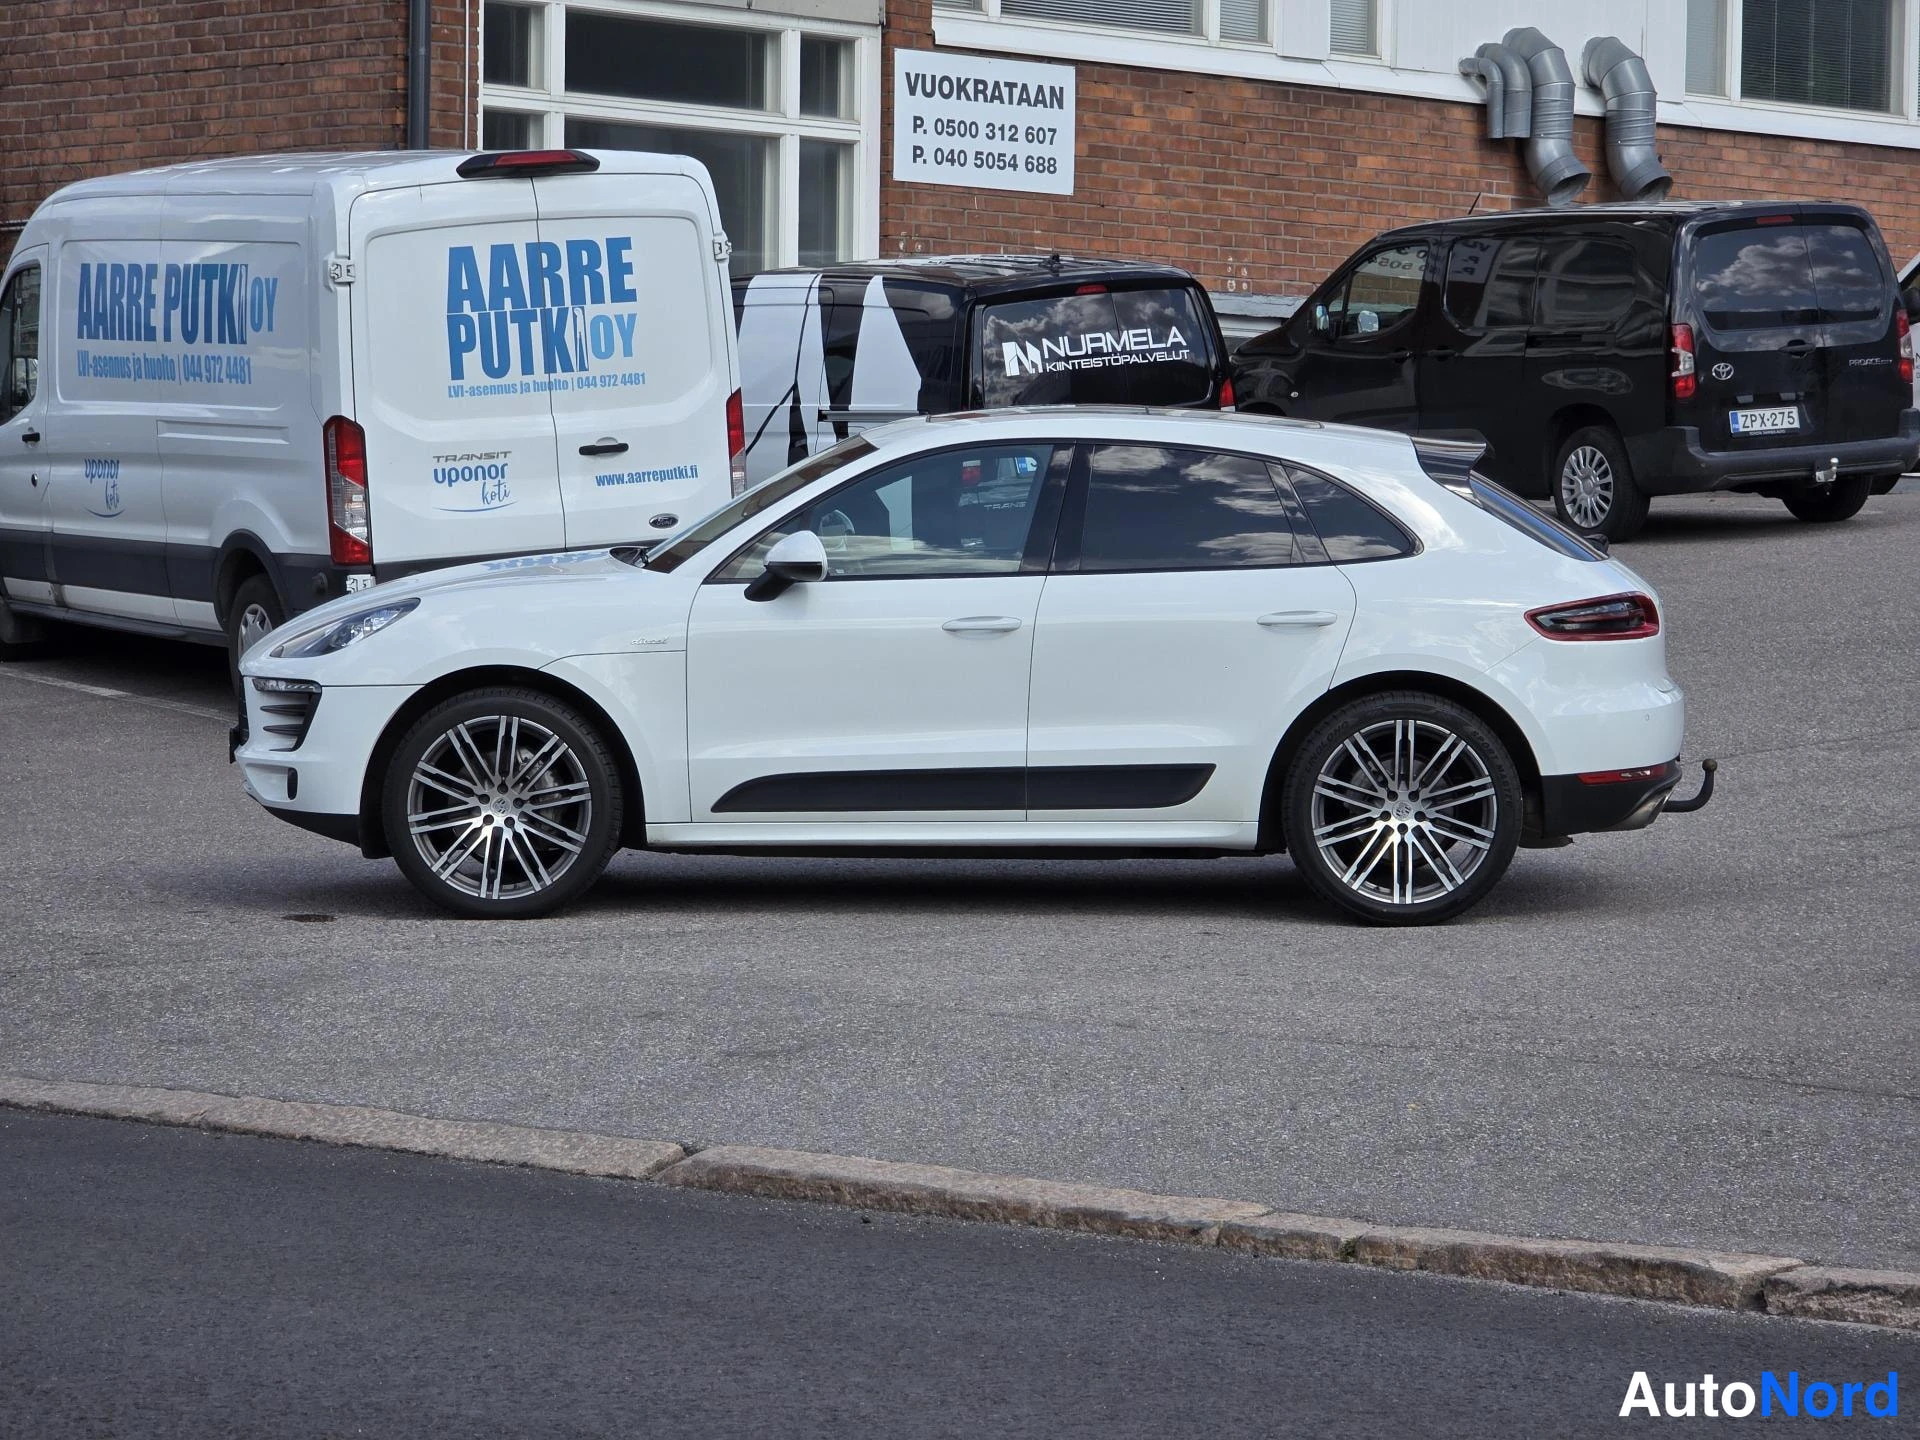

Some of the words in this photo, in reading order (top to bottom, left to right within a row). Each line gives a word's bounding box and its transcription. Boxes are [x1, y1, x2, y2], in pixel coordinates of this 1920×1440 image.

[905, 72, 1064, 110] VUOKRATAAN
[912, 115, 927, 135] P.
[934, 118, 979, 139] 0500
[985, 122, 1018, 142] 312
[1024, 126, 1057, 145] 607
[912, 145, 927, 164] P.
[934, 147, 967, 167] 040
[974, 151, 1018, 171] 5054
[1025, 155, 1057, 174] 688
[447, 237, 637, 314] AARRE
[77, 263, 158, 342] AARRE
[250, 276, 278, 333] OY
[589, 313, 637, 360] OY
[1042, 326, 1187, 359] NURMELA
[77, 350, 132, 379] LVI-asennus
[132, 352, 143, 382] ja
[143, 353, 176, 381] huolto
[183, 353, 201, 382] 044
[205, 355, 223, 384] 972
[226, 356, 252, 385] 4481
[1046, 350, 1190, 373] KIINTEISTÖPALVELUT
[448, 382, 518, 398] LVI-asennus
[520, 380, 531, 395] ja
[533, 378, 569, 393] huolto
[577, 375, 598, 389] 044
[600, 374, 618, 387] 972
[620, 372, 646, 386] 4481
[1741, 411, 1795, 428] ZPX-275
[433, 451, 512, 463] TRANSIT
[85, 459, 119, 484] uponor
[434, 463, 508, 487] uponor
[595, 465, 698, 487] www.aarreputki.fi
[482, 480, 510, 505] koti
